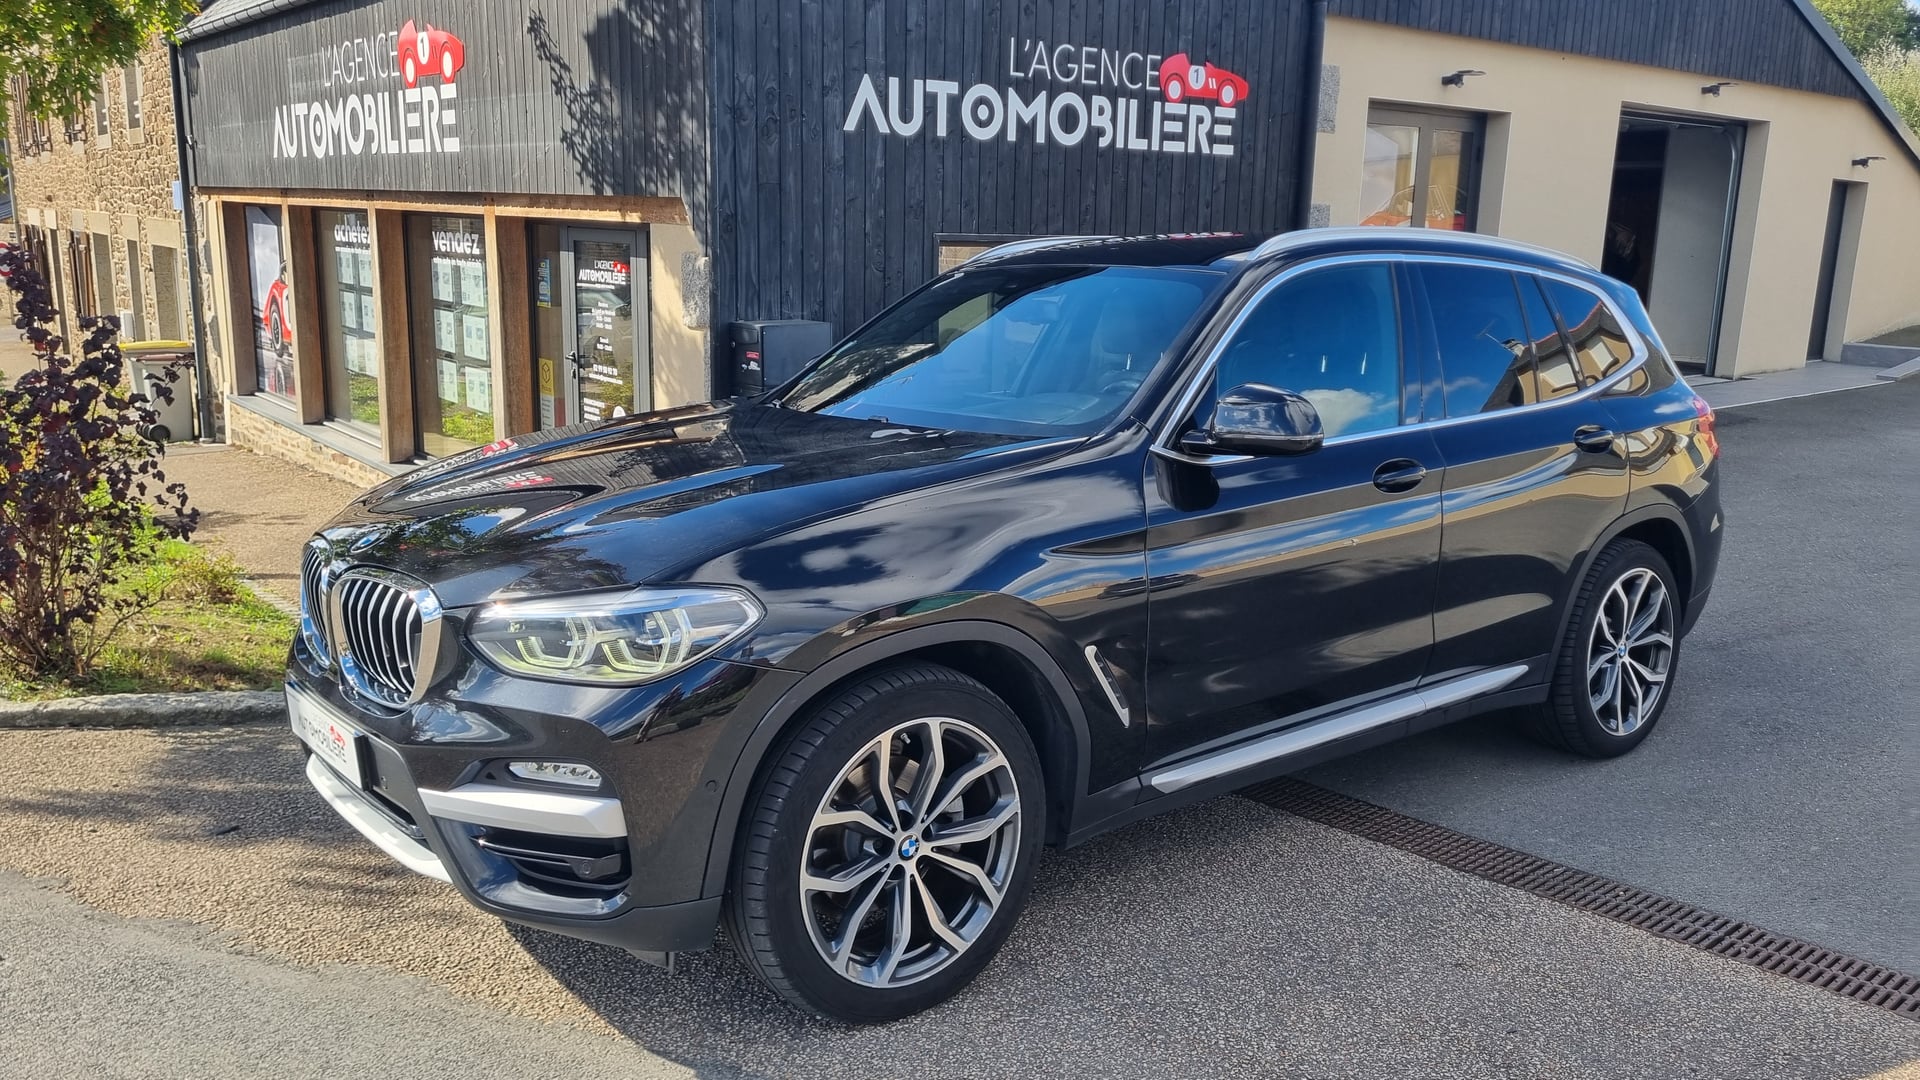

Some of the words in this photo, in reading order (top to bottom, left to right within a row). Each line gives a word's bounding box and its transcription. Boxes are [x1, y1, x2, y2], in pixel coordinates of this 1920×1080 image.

[322, 31, 400, 86] L'AGENCE
[1010, 37, 1162, 91] L'AGENCE
[273, 83, 461, 159] AUTOMOBILIERE
[843, 73, 1237, 155] AUTOMOBILIERE
[432, 219, 481, 255] vendez
